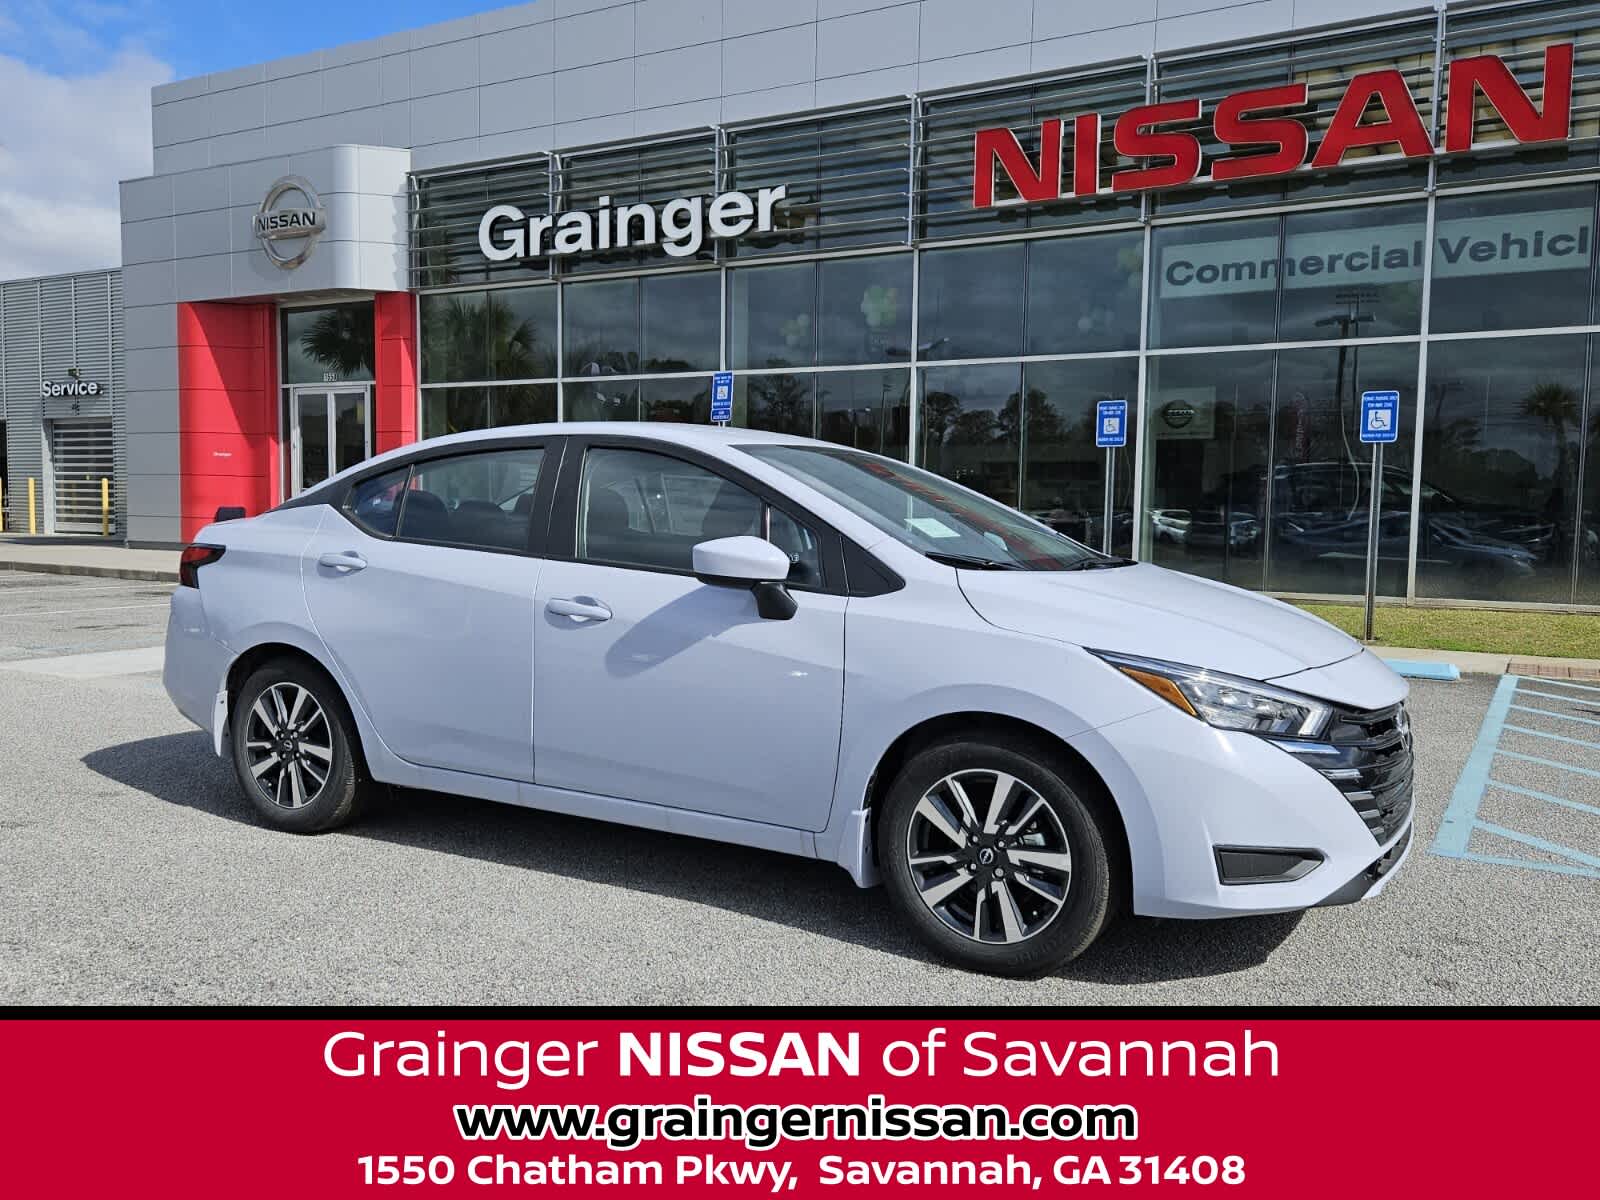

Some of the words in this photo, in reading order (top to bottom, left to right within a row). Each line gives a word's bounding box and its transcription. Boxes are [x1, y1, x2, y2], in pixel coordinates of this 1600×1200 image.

[972, 42, 1574, 208] NISSAN
[258, 211, 316, 231] NISSAN
[478, 184, 786, 261] Grainger
[1165, 240, 1423, 286] Commercial
